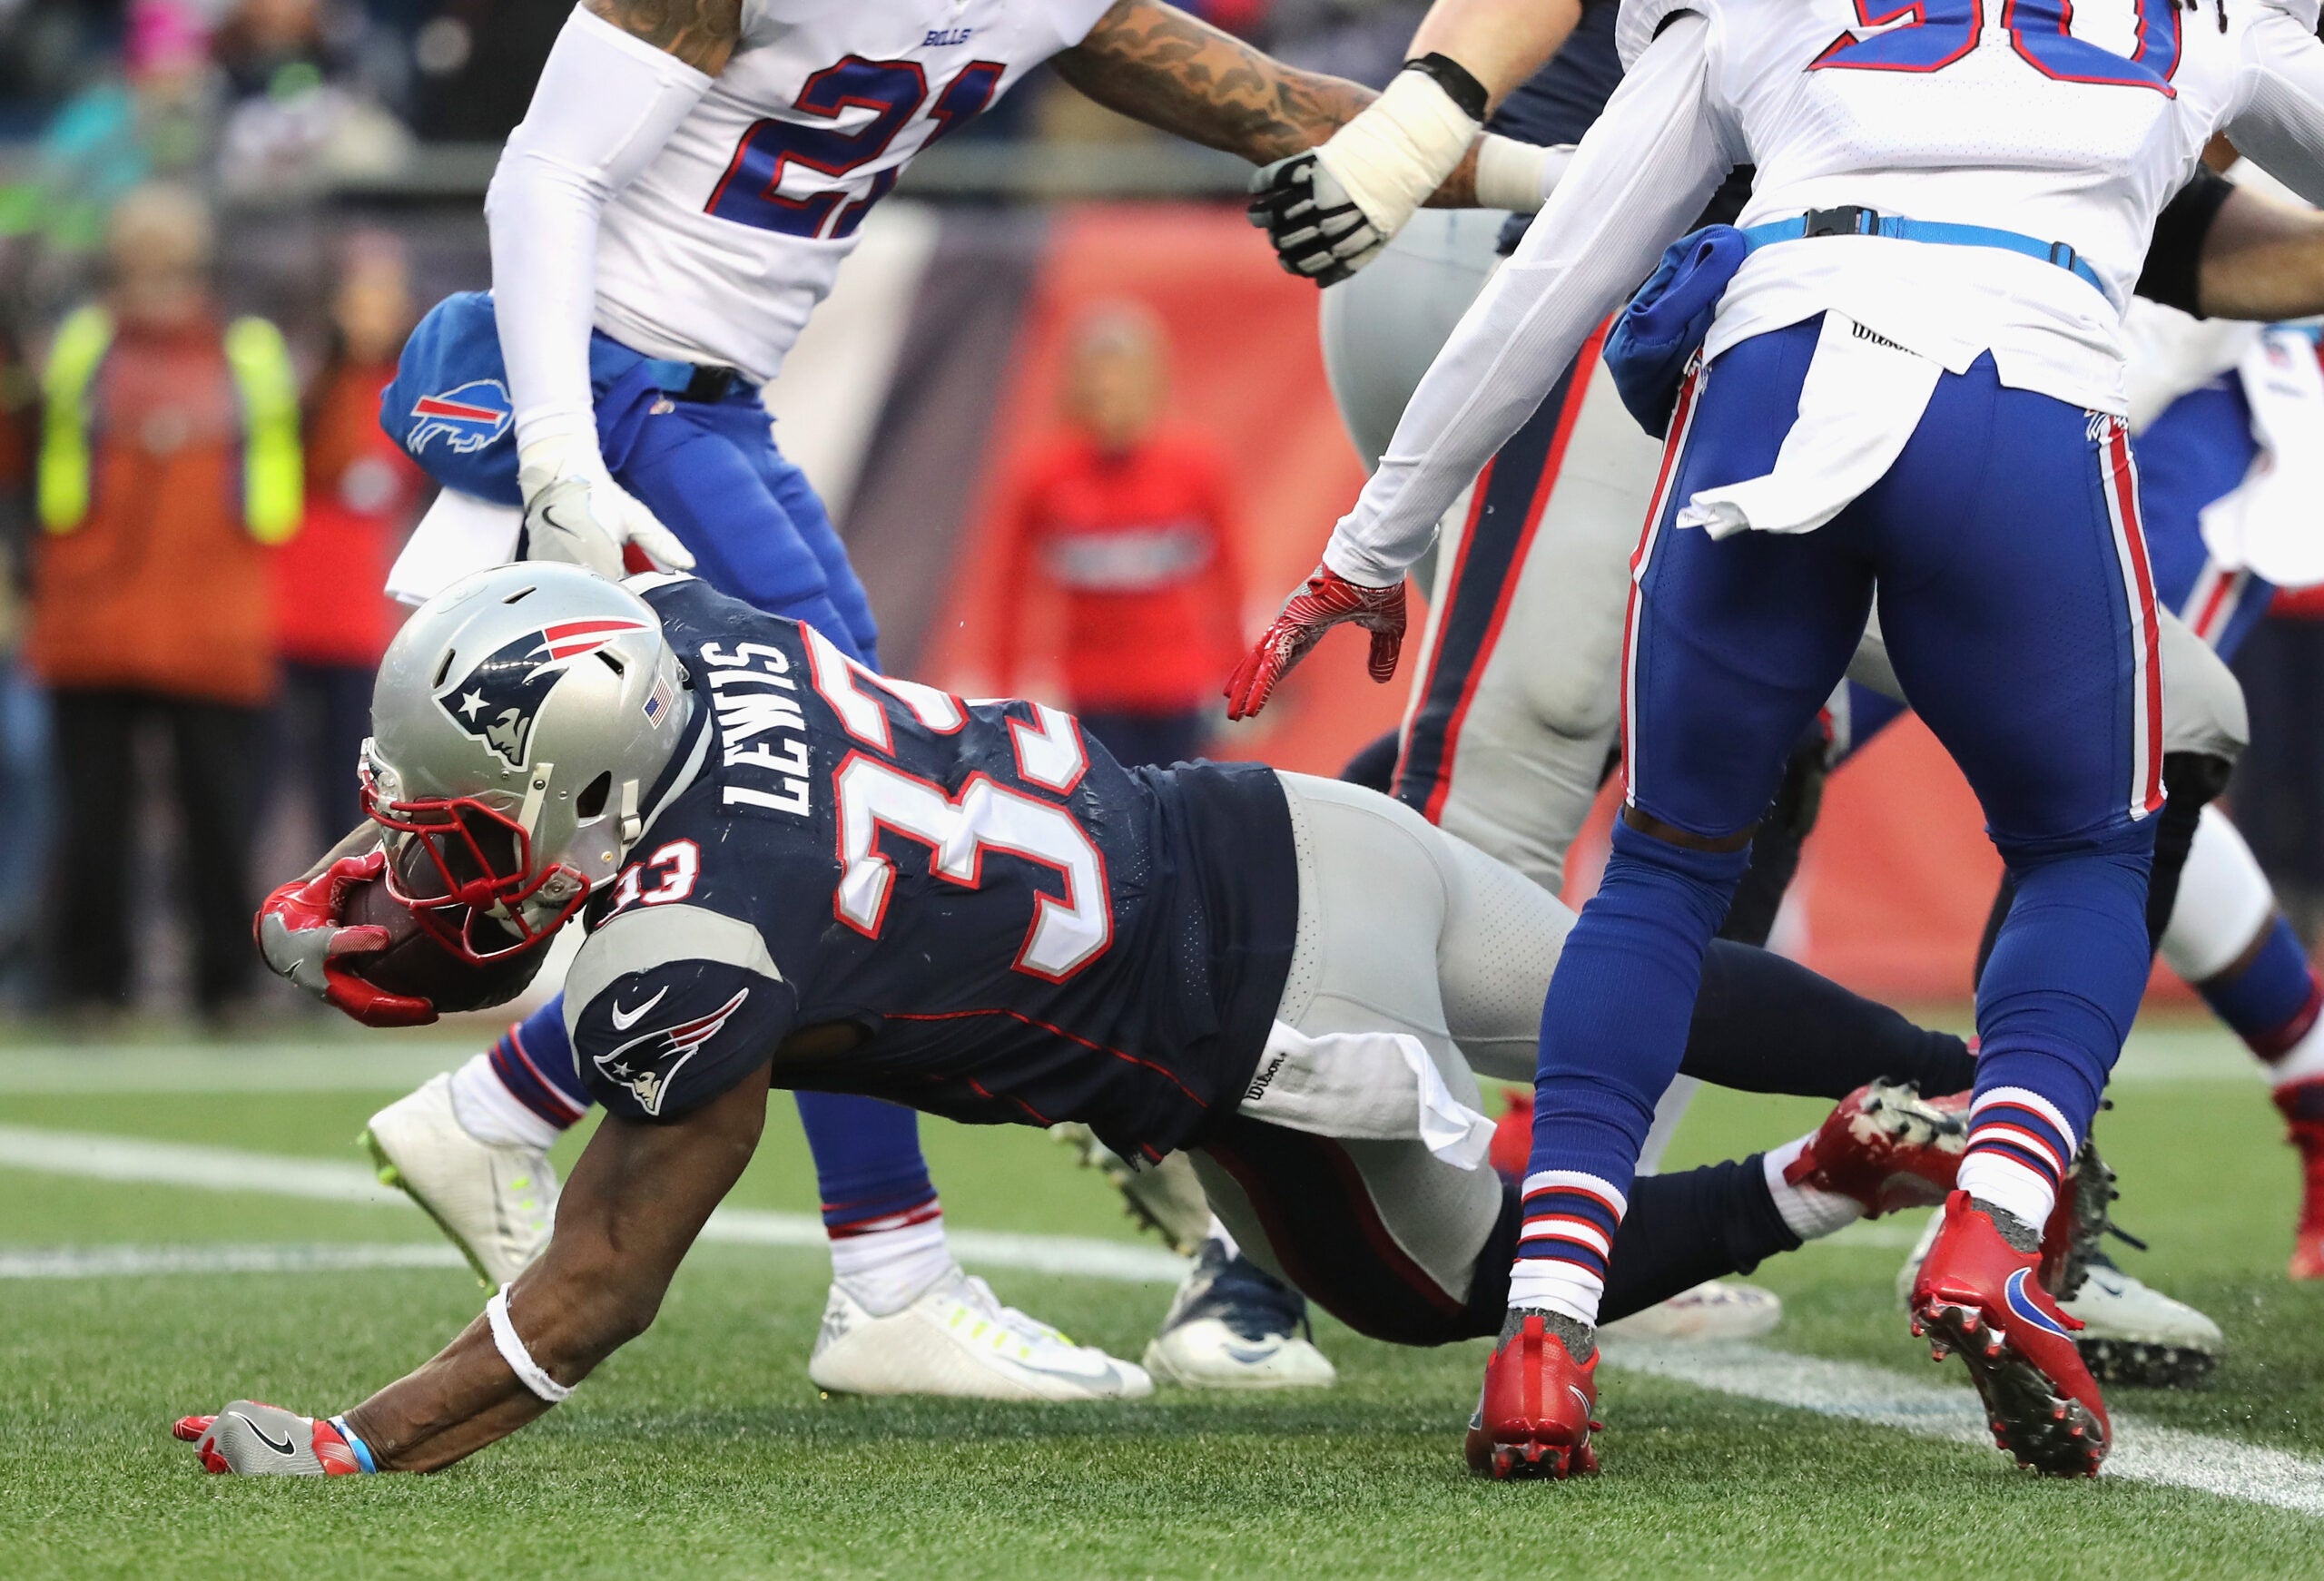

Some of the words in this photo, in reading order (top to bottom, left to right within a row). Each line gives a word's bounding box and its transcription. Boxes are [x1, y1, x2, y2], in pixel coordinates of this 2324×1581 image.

[921, 28, 971, 46] BILLS
[704, 54, 1007, 240] 21
[700, 641, 811, 817] LEWIS
[799, 620, 1115, 985] 33
[1244, 1055, 1285, 1100] Wilson
